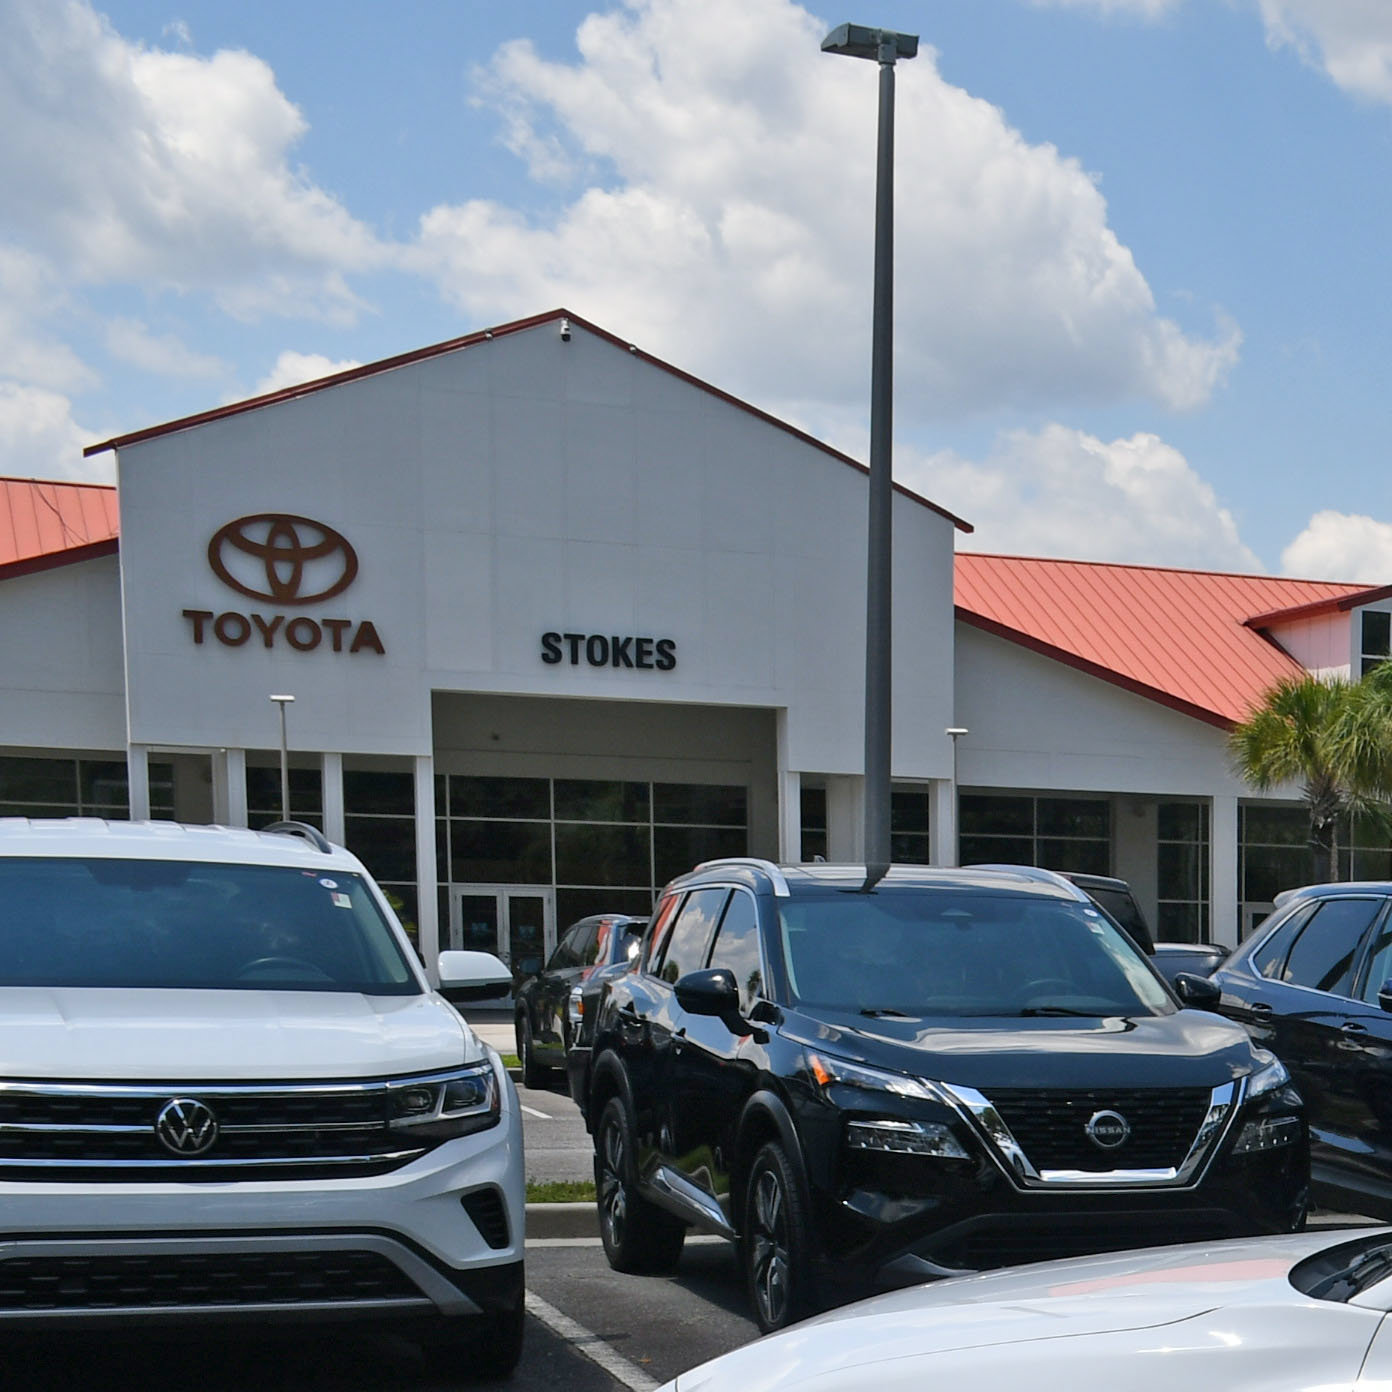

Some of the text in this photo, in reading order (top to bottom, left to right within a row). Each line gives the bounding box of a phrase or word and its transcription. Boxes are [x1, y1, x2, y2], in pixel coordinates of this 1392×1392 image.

[182, 609, 385, 655] TOYOTA
[540, 631, 678, 671] STOKES
[1085, 1126, 1131, 1135] NISSAN
